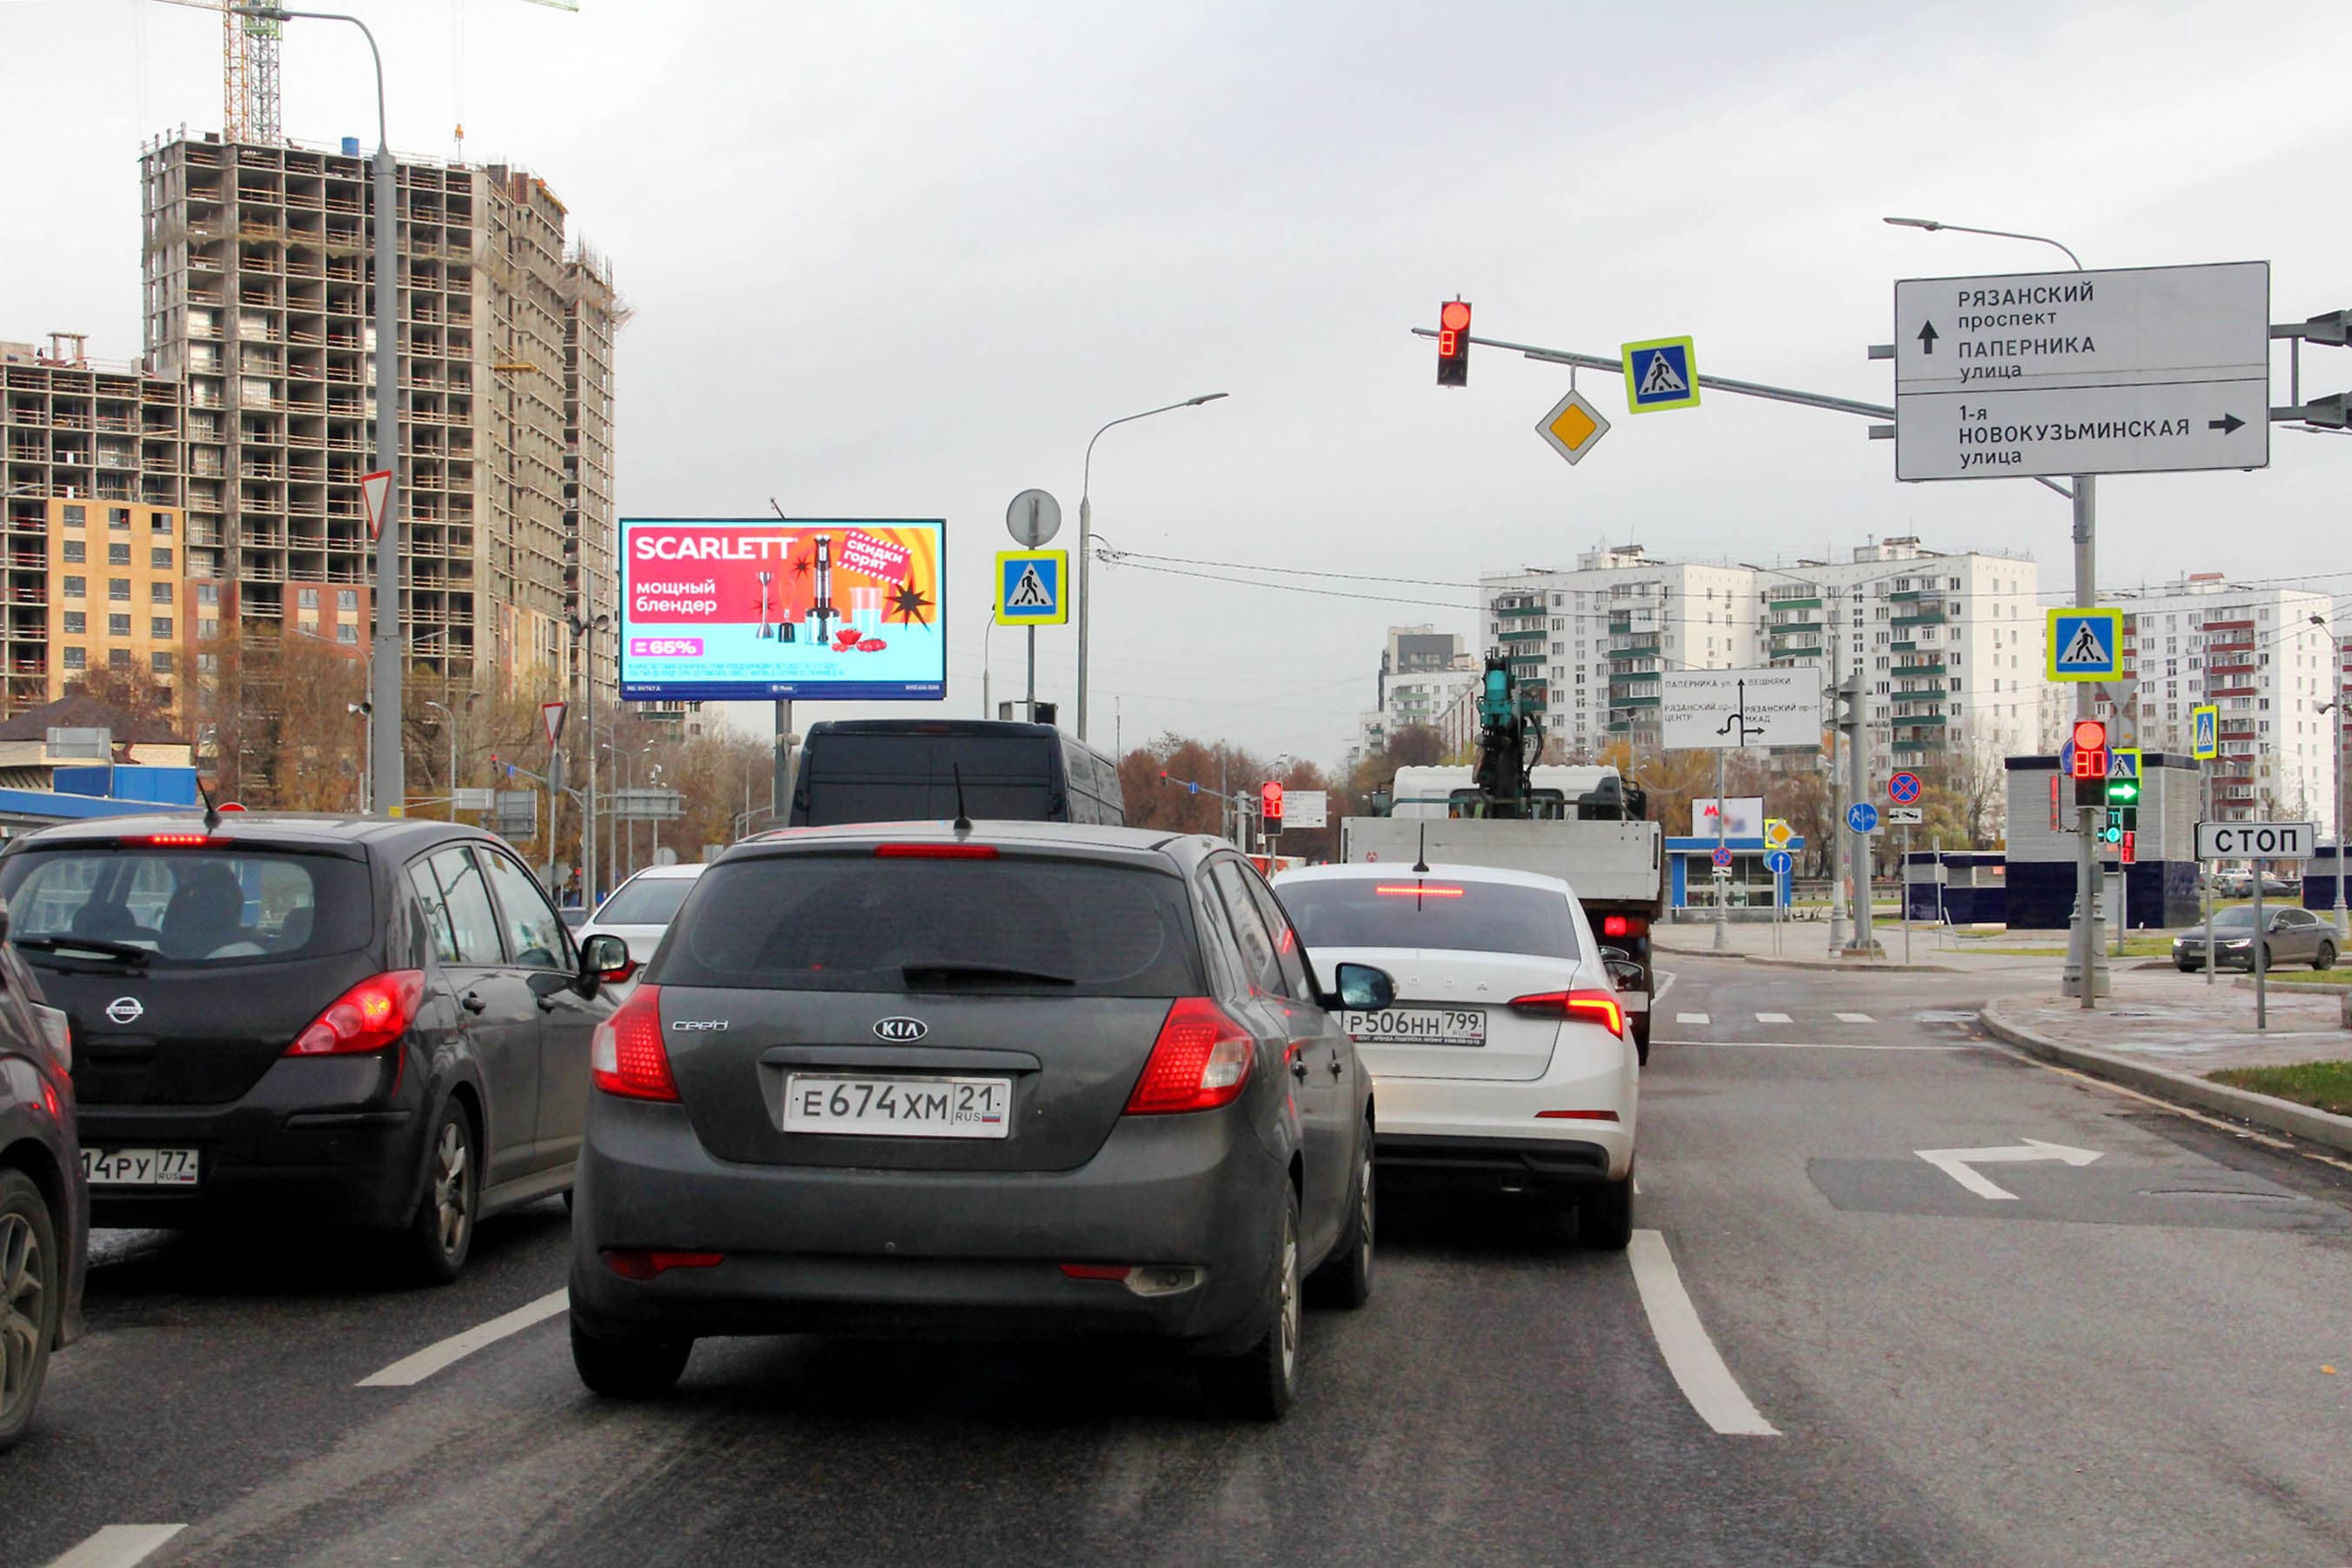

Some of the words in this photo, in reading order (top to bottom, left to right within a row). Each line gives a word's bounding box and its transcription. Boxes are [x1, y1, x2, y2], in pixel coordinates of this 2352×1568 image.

[1958, 281, 2094, 307] РЯЗАНСКИЙ
[1959, 312, 2056, 332] проспект
[1959, 337, 2095, 358] ПАПЕРНИКА
[1960, 364, 2022, 384] улица
[1959, 405, 1988, 422] 1-я
[1959, 418, 2189, 444] НОВОКУЗЬМИНСКАЯ
[1960, 450, 2022, 470] улица
[636, 536, 795, 560] SCARLETT
[636, 578, 716, 597] мощный
[636, 596, 718, 615] блендер
[1665, 680, 1717, 689] ПАПЕРНИКА
[1664, 702, 1717, 711] РЯЗАНСКИЙ
[1745, 703, 1796, 712] РЯЗАНСКИЙ
[1664, 714, 1693, 723] ЦЕНТР
[2215, 829, 2297, 852] СТОП
[882, 1022, 919, 1037] KIA
[1445, 1012, 1479, 1031] 799
[803, 1084, 948, 1120] Е674ХМ
[958, 1085, 992, 1111] 21
[955, 1112, 981, 1122] RUS
[160, 1151, 190, 1172] 77
[158, 1172, 179, 1181] RUS
